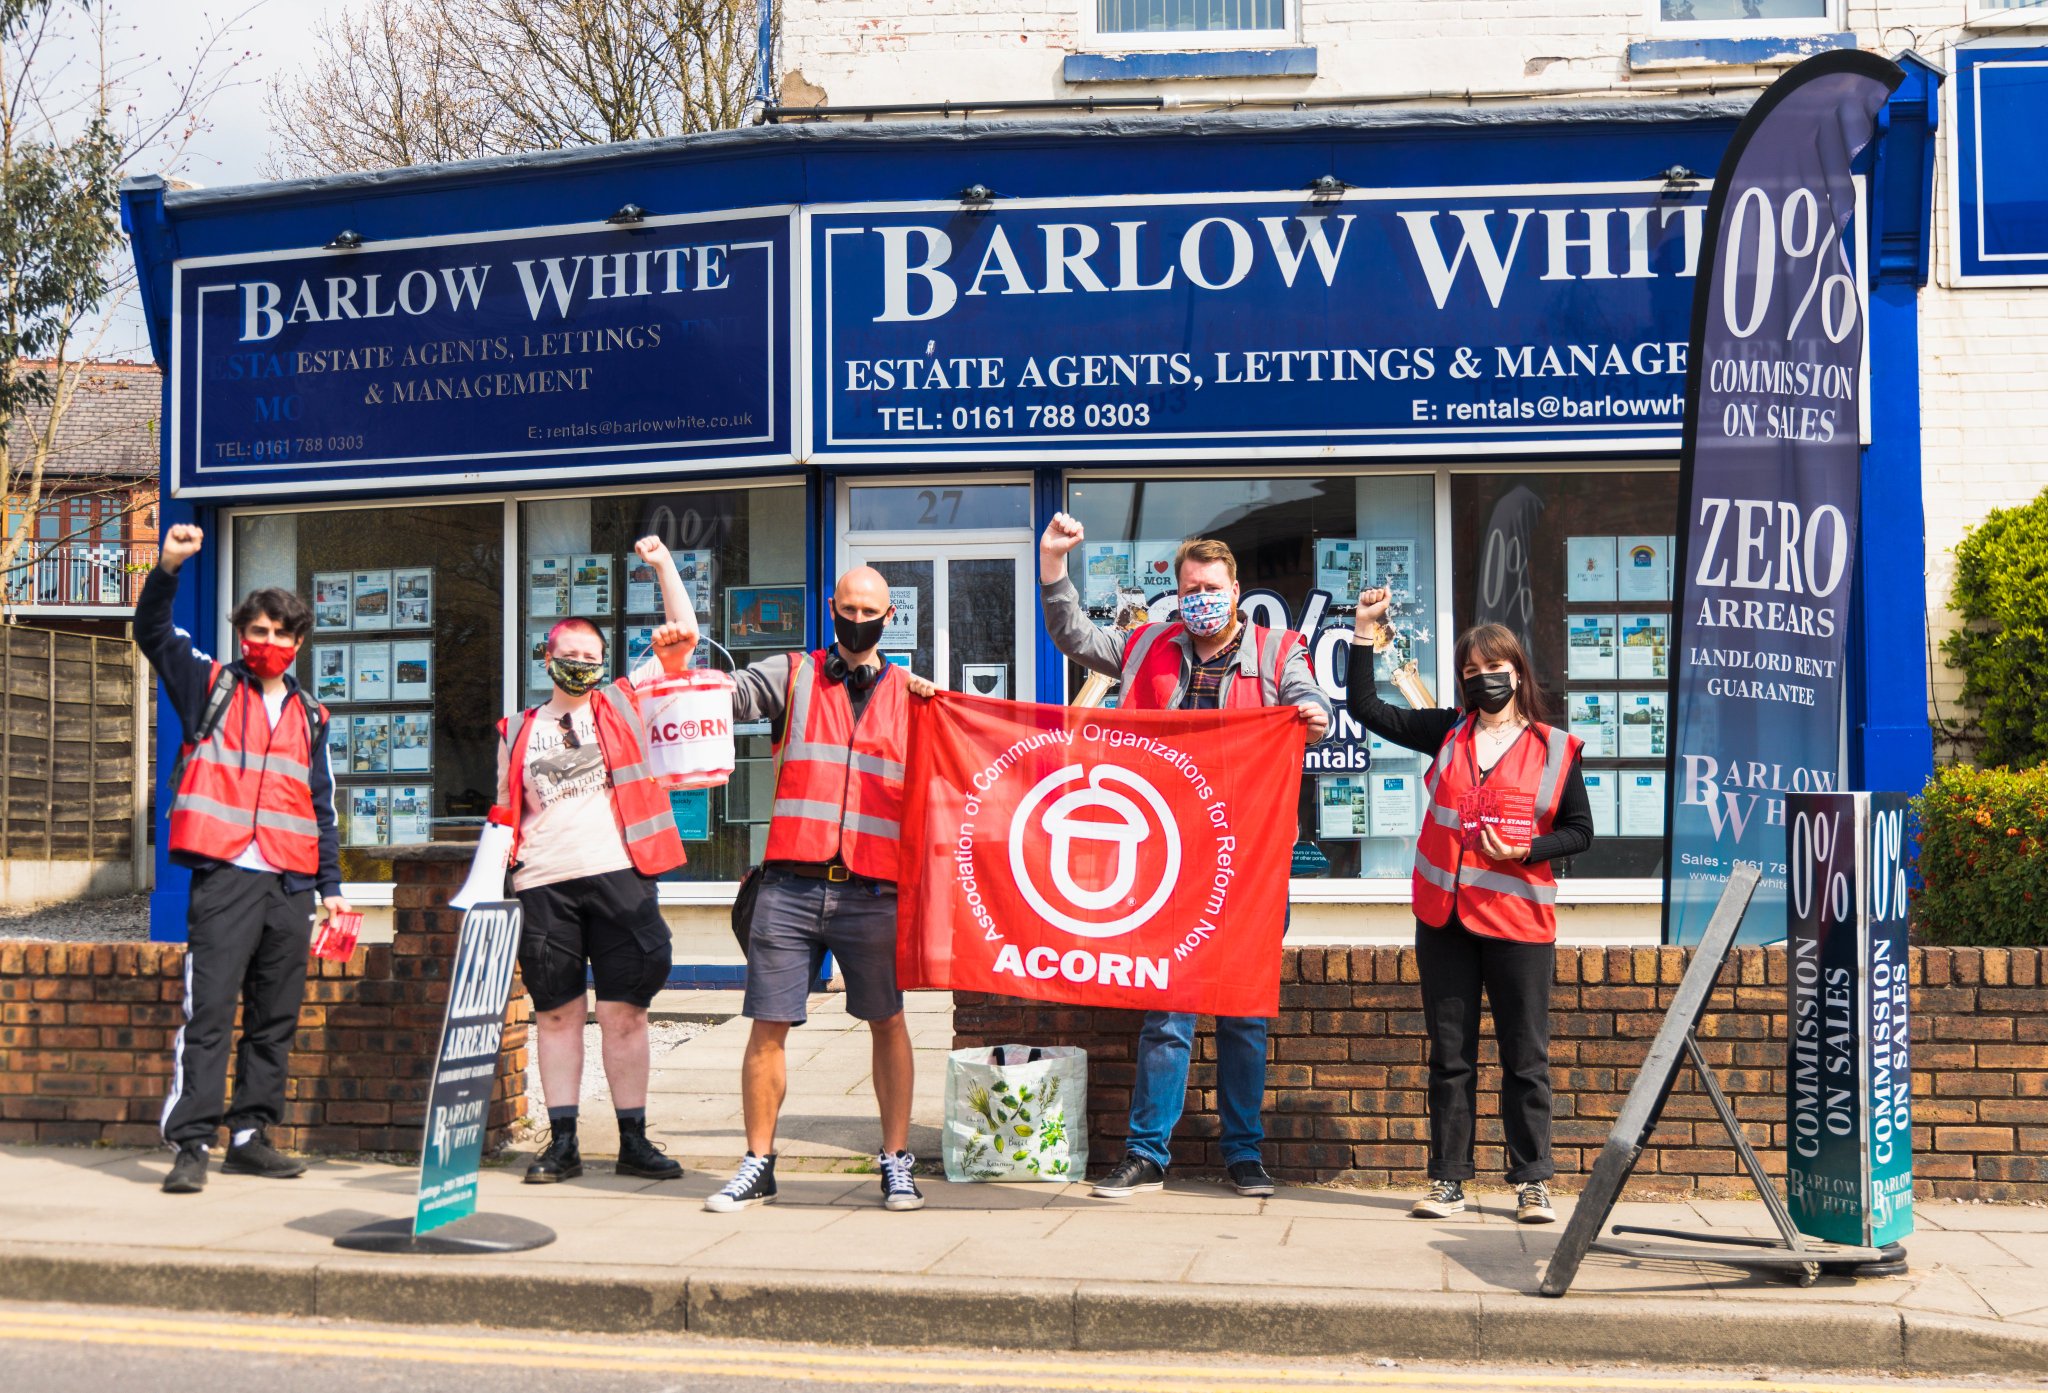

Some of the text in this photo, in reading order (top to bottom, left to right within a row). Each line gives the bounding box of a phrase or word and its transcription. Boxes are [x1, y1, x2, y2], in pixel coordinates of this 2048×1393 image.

[872, 205, 1708, 322] BARLOW WHIT
[1723, 186, 1858, 344] 0%
[239, 244, 730, 343] BARLOW WHITE
[297, 323, 662, 375] ESTATE AGENTS, LETTINGS
[844, 341, 1690, 392] ESTATE AGENTS, LETTINGS & MANAGE
[364, 367, 593, 405] & MANAGEMENT
[1710, 359, 1853, 400] COMMISSION
[528, 411, 754, 440] E: rentals@barlowwhite.co.uk
[878, 403, 1150, 431] TEL: 0161 788 0303
[1412, 395, 1685, 421] E: rentals@barlowwh
[1723, 404, 1836, 443] ON SALES
[215, 435, 363, 458] TEL: 0161 788 0303
[917, 490, 963, 525] 27
[1145, 560, 1153, 574] I
[1696, 497, 1848, 598] ZERO
[1144, 576, 1171, 585] MCR
[1697, 597, 1835, 638] ARREARS
[1690, 647, 1836, 679] LANDLORD RENT
[1707, 678, 1815, 707] GUARANTEE
[1302, 745, 1366, 769] ntals
[1680, 754, 1836, 805] BARLOW
[954, 723, 1236, 962] Association of Community Organizations for Reform Now
[1681, 853, 1719, 867] Sales
[1792, 811, 1849, 923] 0%
[1874, 809, 1906, 923] 0%
[451, 907, 521, 1019] ZERO
[992, 944, 1169, 990] ACORN
[443, 1021, 503, 1061] ARREARS
[1796, 936, 1819, 1158] COMMISSION
[1825, 967, 1852, 1136] ON SALES
[1874, 938, 1892, 1164] COMMISSION
[1893, 963, 1908, 1131] ON SALES
[432, 1099, 484, 1146] BARLOW
[438, 1123, 480, 1169] WHITE
[1789, 1168, 1858, 1197] BARLOW
[1798, 1186, 1858, 1217] WHITE
[1872, 1171, 1911, 1210] BARLOW
[1879, 1189, 1912, 1225] WHITE
